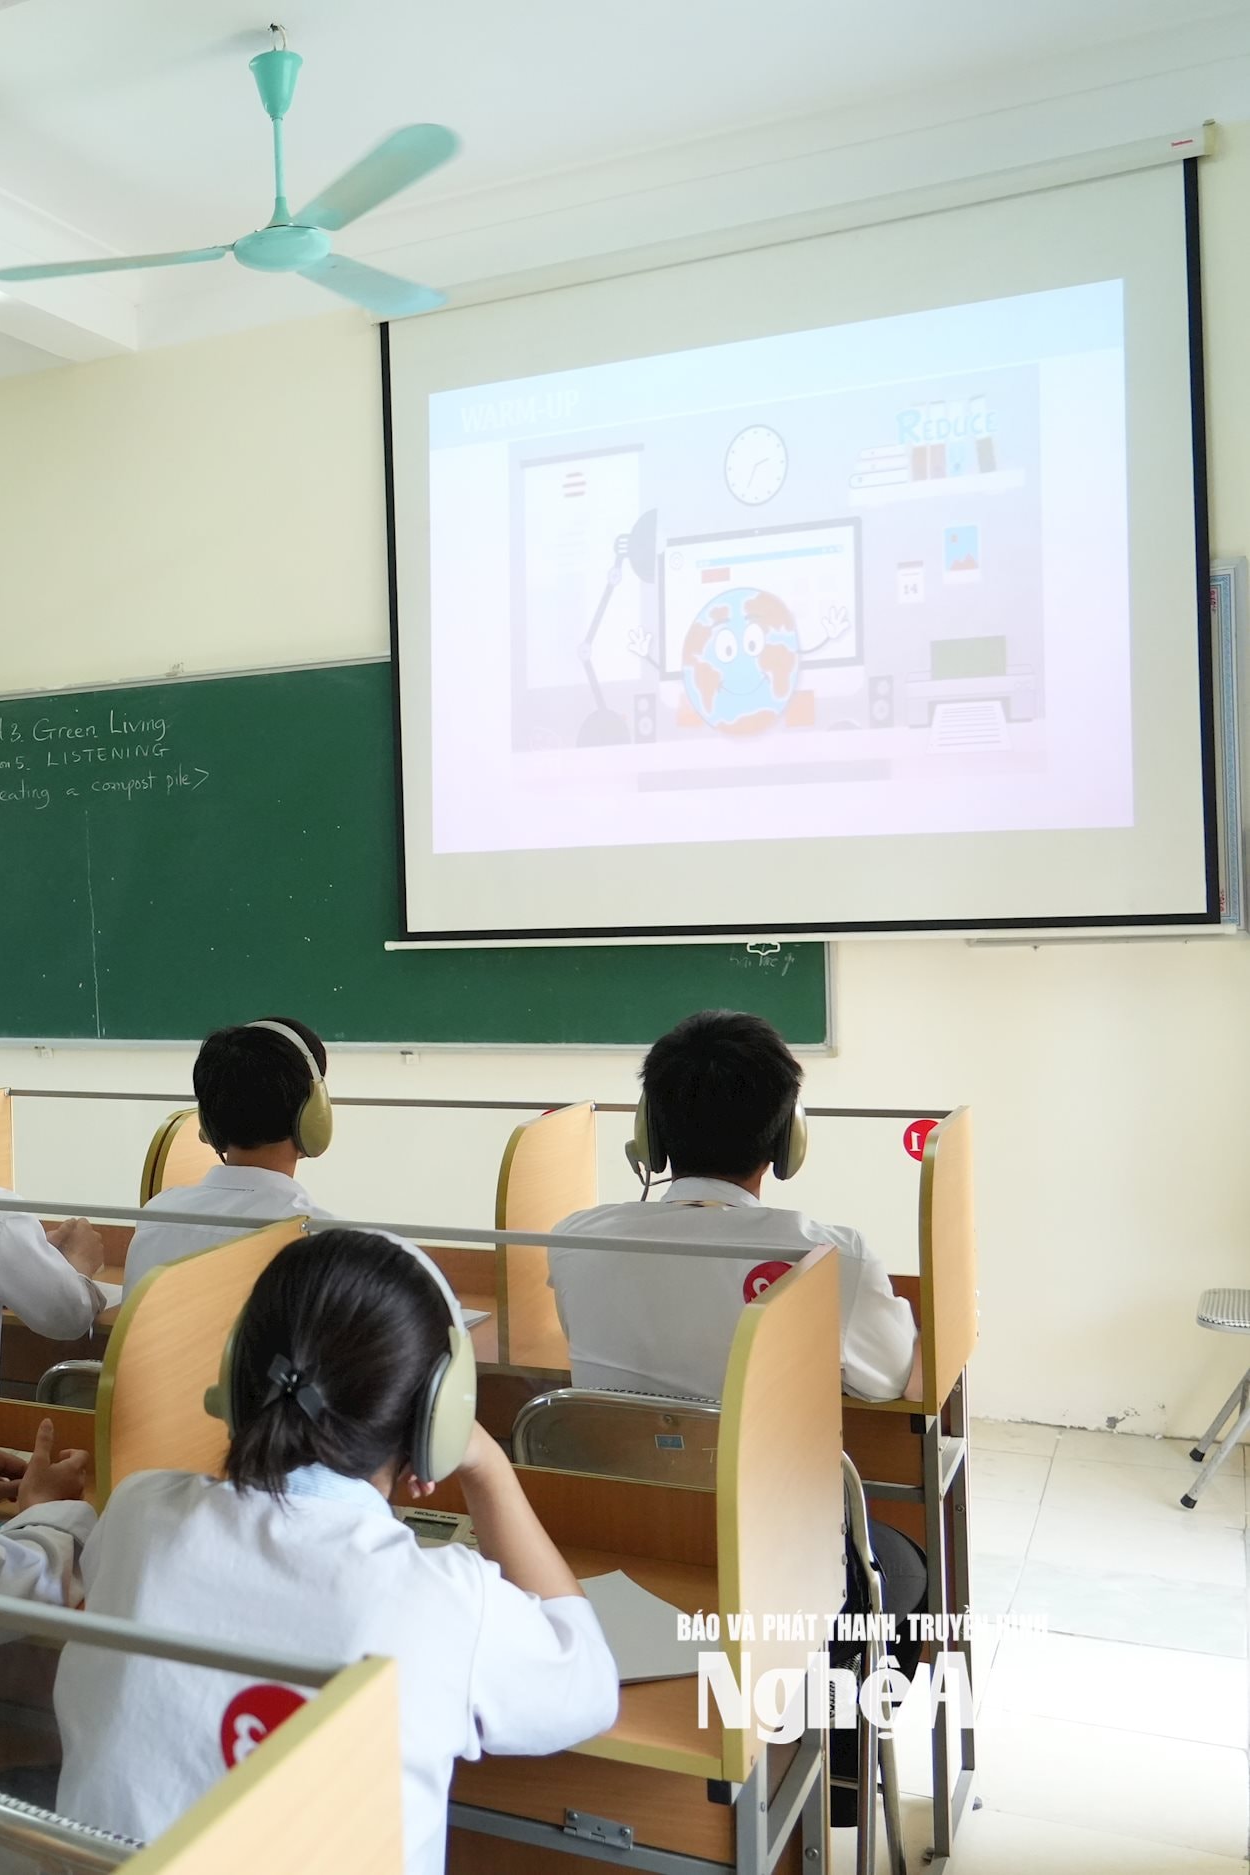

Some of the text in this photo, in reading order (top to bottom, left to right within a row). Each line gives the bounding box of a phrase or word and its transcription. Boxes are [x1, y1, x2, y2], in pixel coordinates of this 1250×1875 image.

[460, 390, 580, 433] WARM-UP
[895, 408, 998, 444] REDUCE
[110, 709, 166, 742] Living
[47, 743, 170, 767] LISTENING
[66, 787, 80, 796] a
[91, 771, 157, 801] compost
